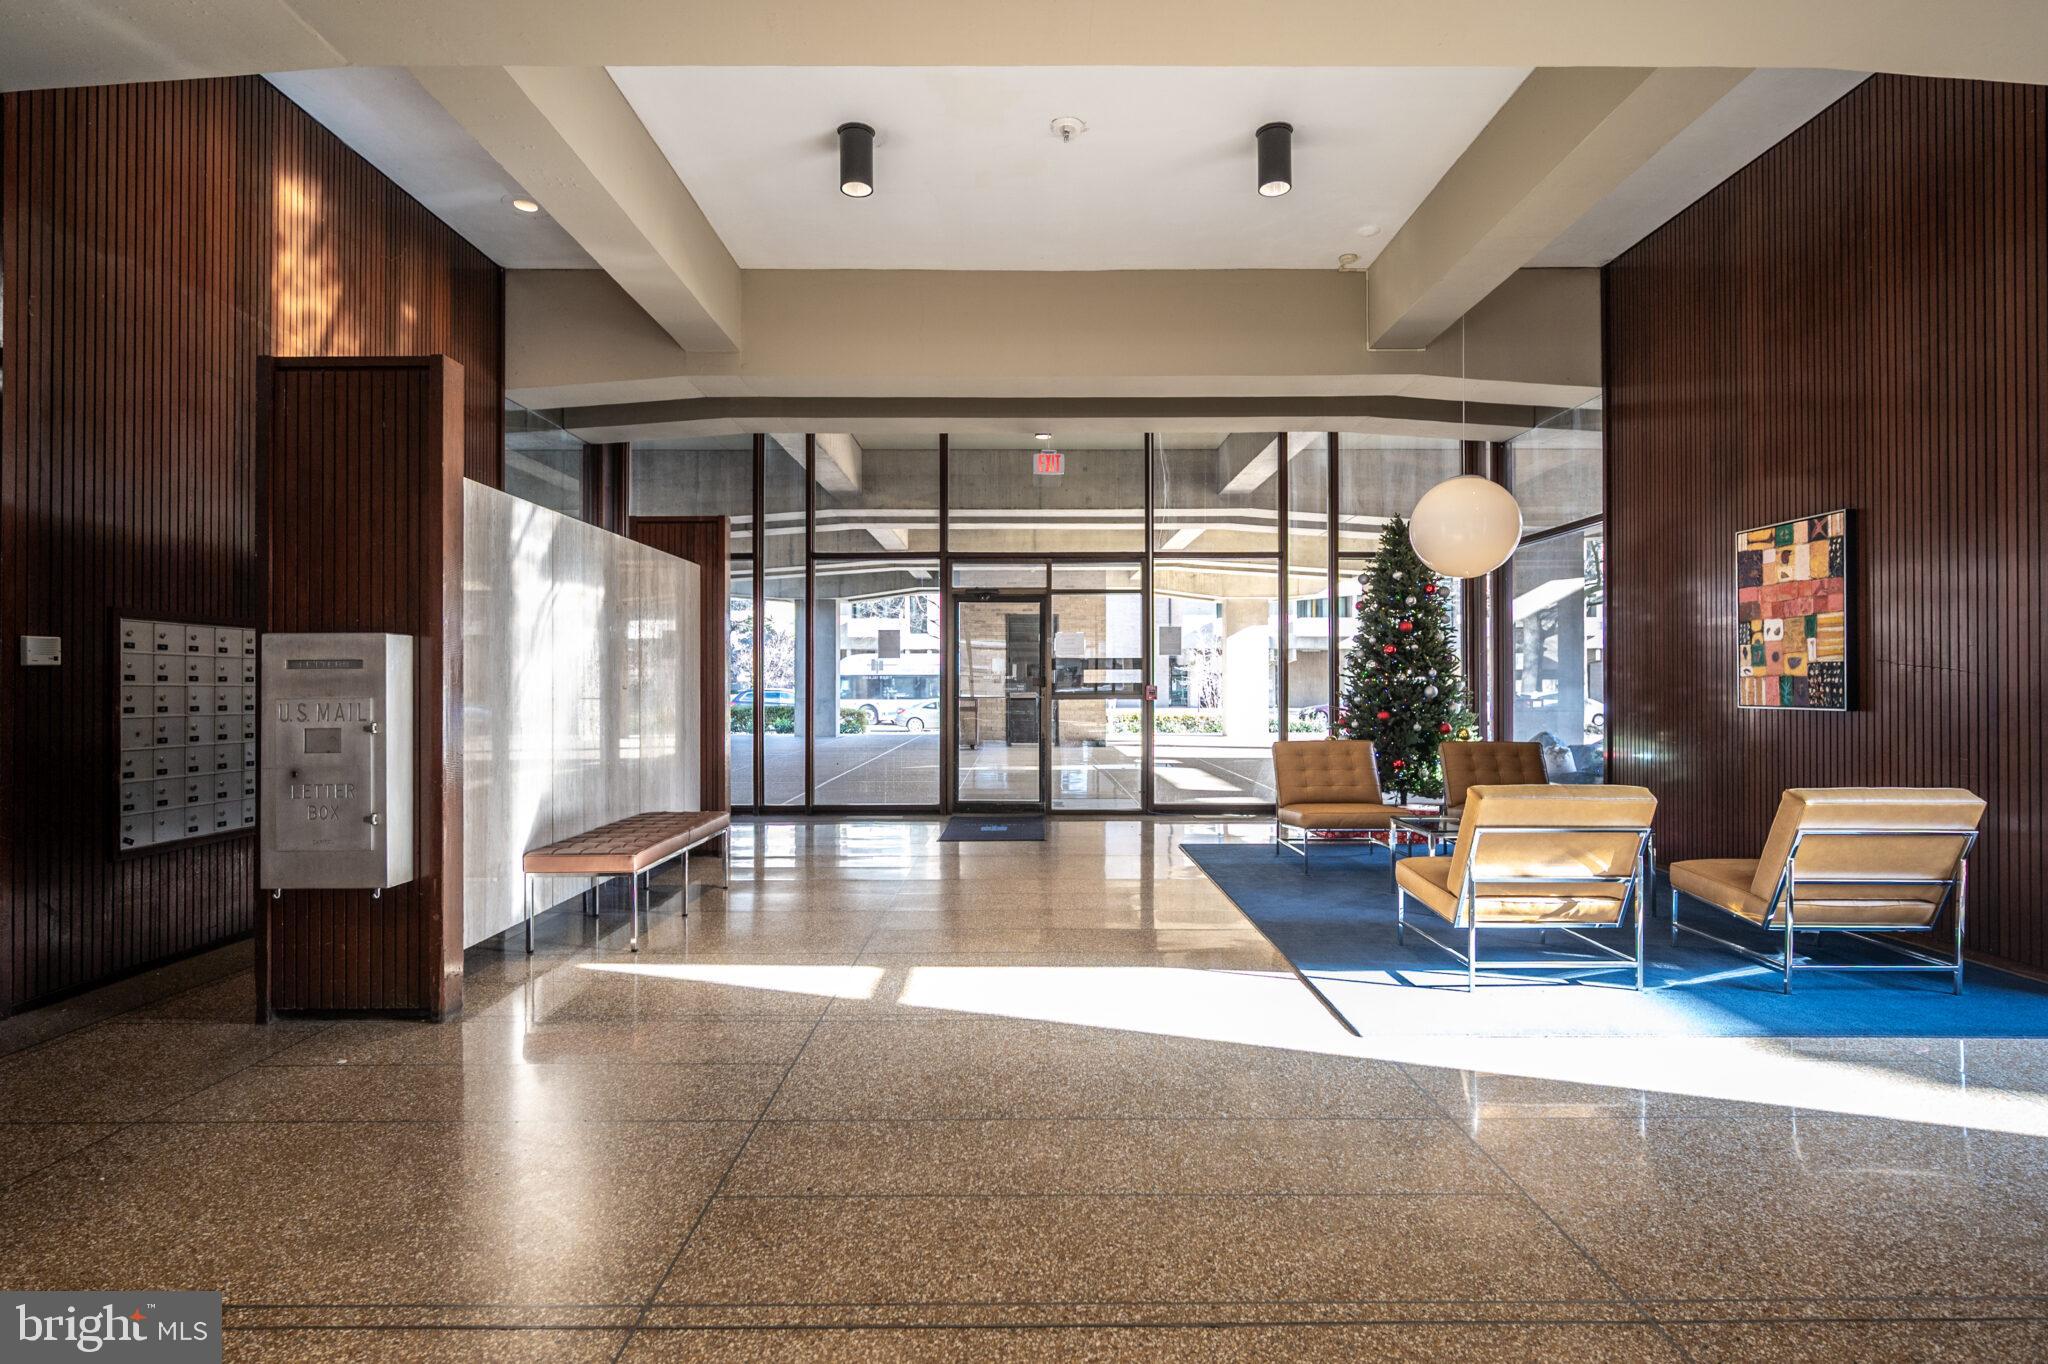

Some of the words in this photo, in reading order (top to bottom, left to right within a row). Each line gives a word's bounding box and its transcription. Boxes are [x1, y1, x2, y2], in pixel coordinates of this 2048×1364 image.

[1038, 454, 1061, 472] EXIT
[279, 703, 310, 722] U.S.
[317, 703, 367, 722] MAIL
[290, 784, 355, 800] LETTER
[307, 805, 339, 820] BOX
